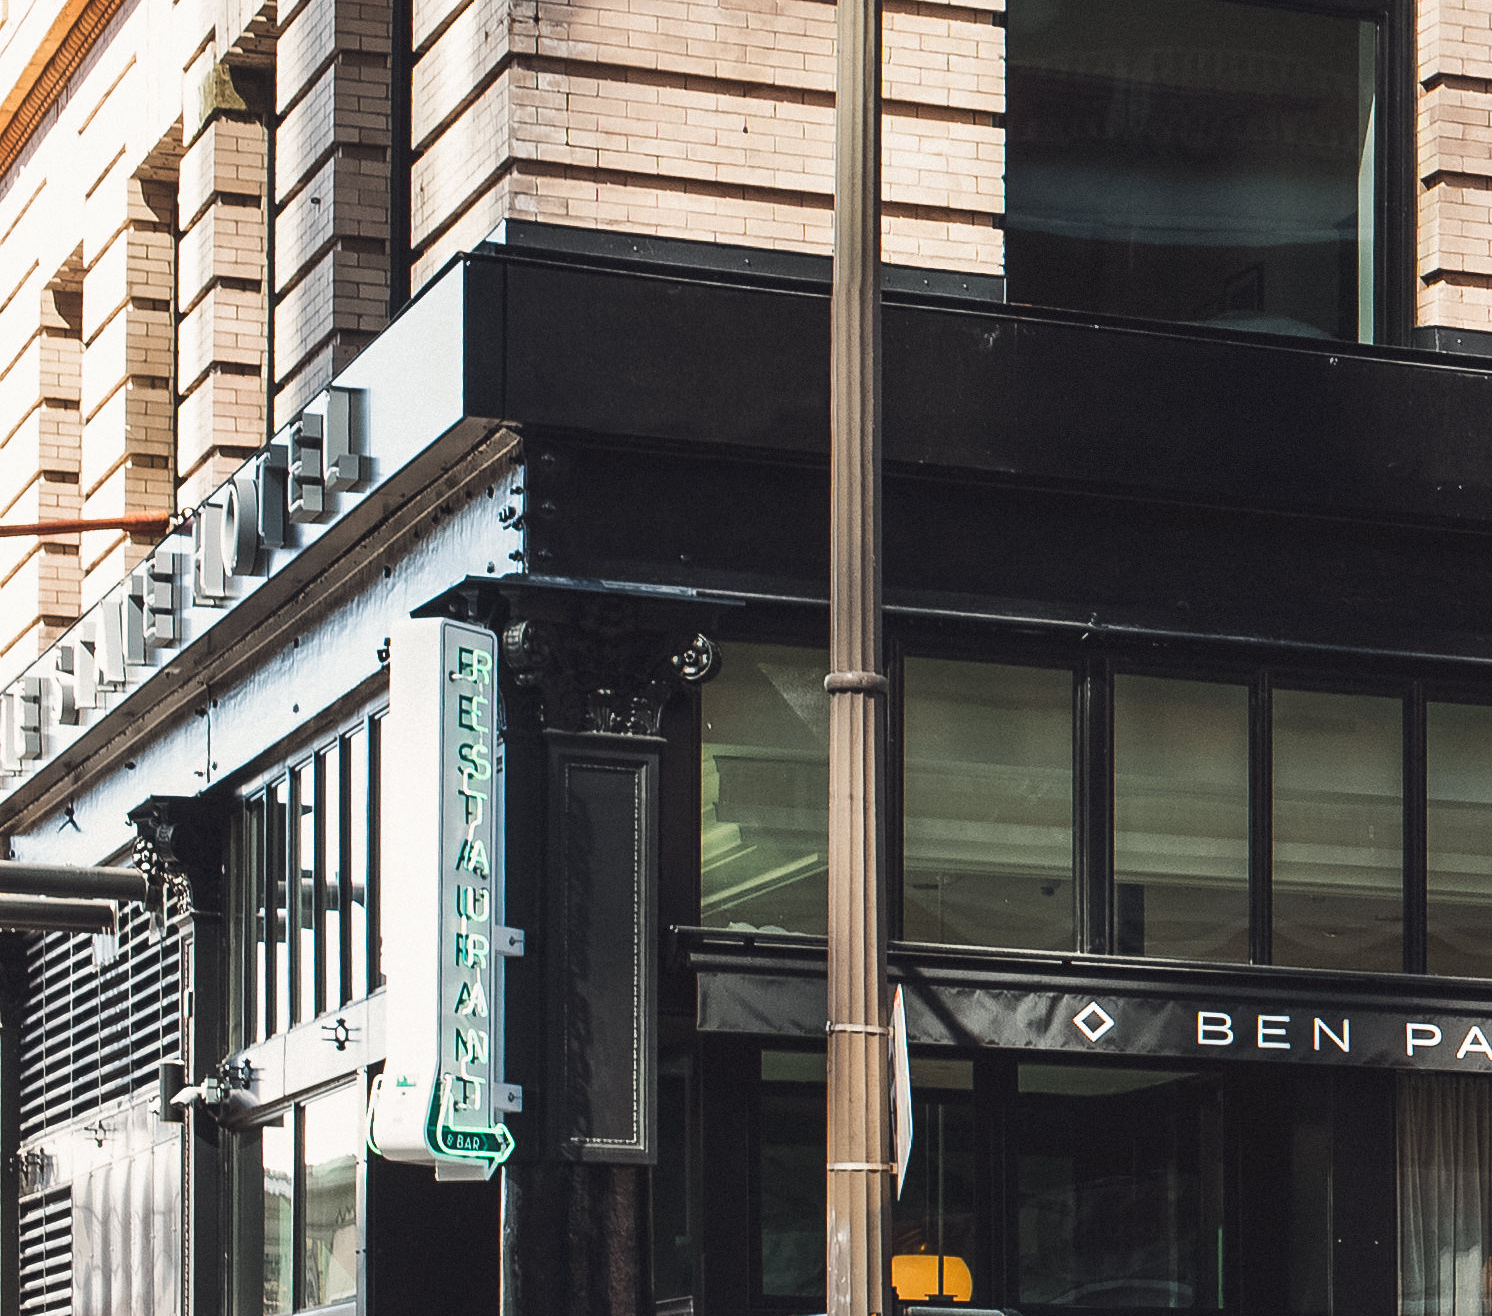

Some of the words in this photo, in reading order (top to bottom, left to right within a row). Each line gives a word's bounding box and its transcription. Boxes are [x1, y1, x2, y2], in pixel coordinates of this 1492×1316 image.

[455, 645, 494, 1112] RESTAURANT
[1196, 1010, 1351, 1052] BEN
[456, 1133, 481, 1151] BAR
